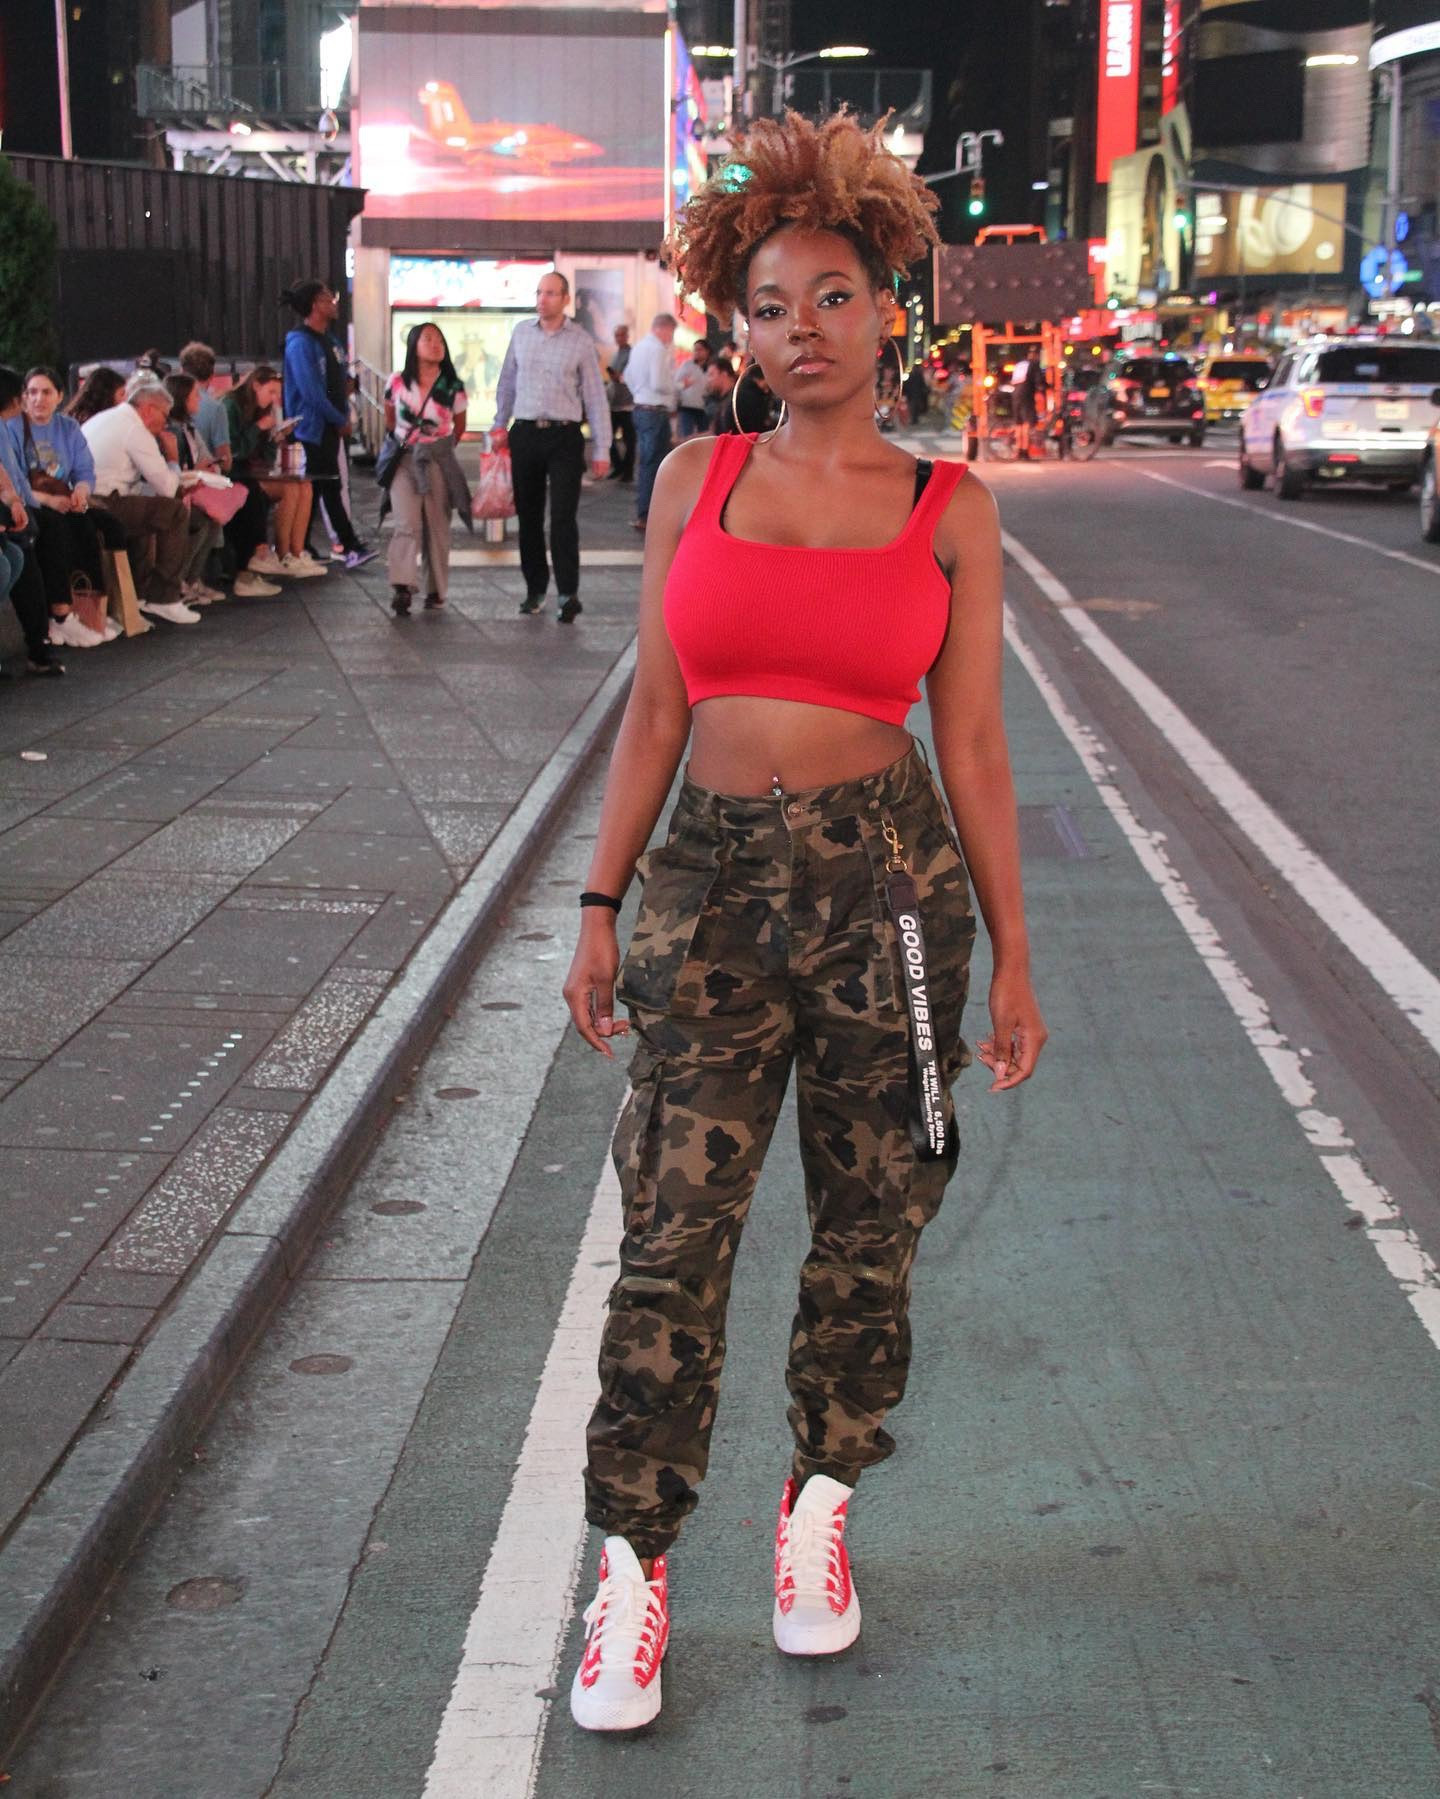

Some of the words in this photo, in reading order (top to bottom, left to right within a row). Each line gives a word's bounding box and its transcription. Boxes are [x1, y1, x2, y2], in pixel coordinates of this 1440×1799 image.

[899, 915, 924, 980] GOOD
[912, 985, 933, 1051] VIBES
[928, 1060, 937, 1076] TM
[930, 1077, 940, 1104] WILL
[922, 1067, 930, 1092] Weight
[928, 1123, 936, 1149] System
[934, 1111, 945, 1139] 6,500
[936, 1140, 945, 1155] lbs
